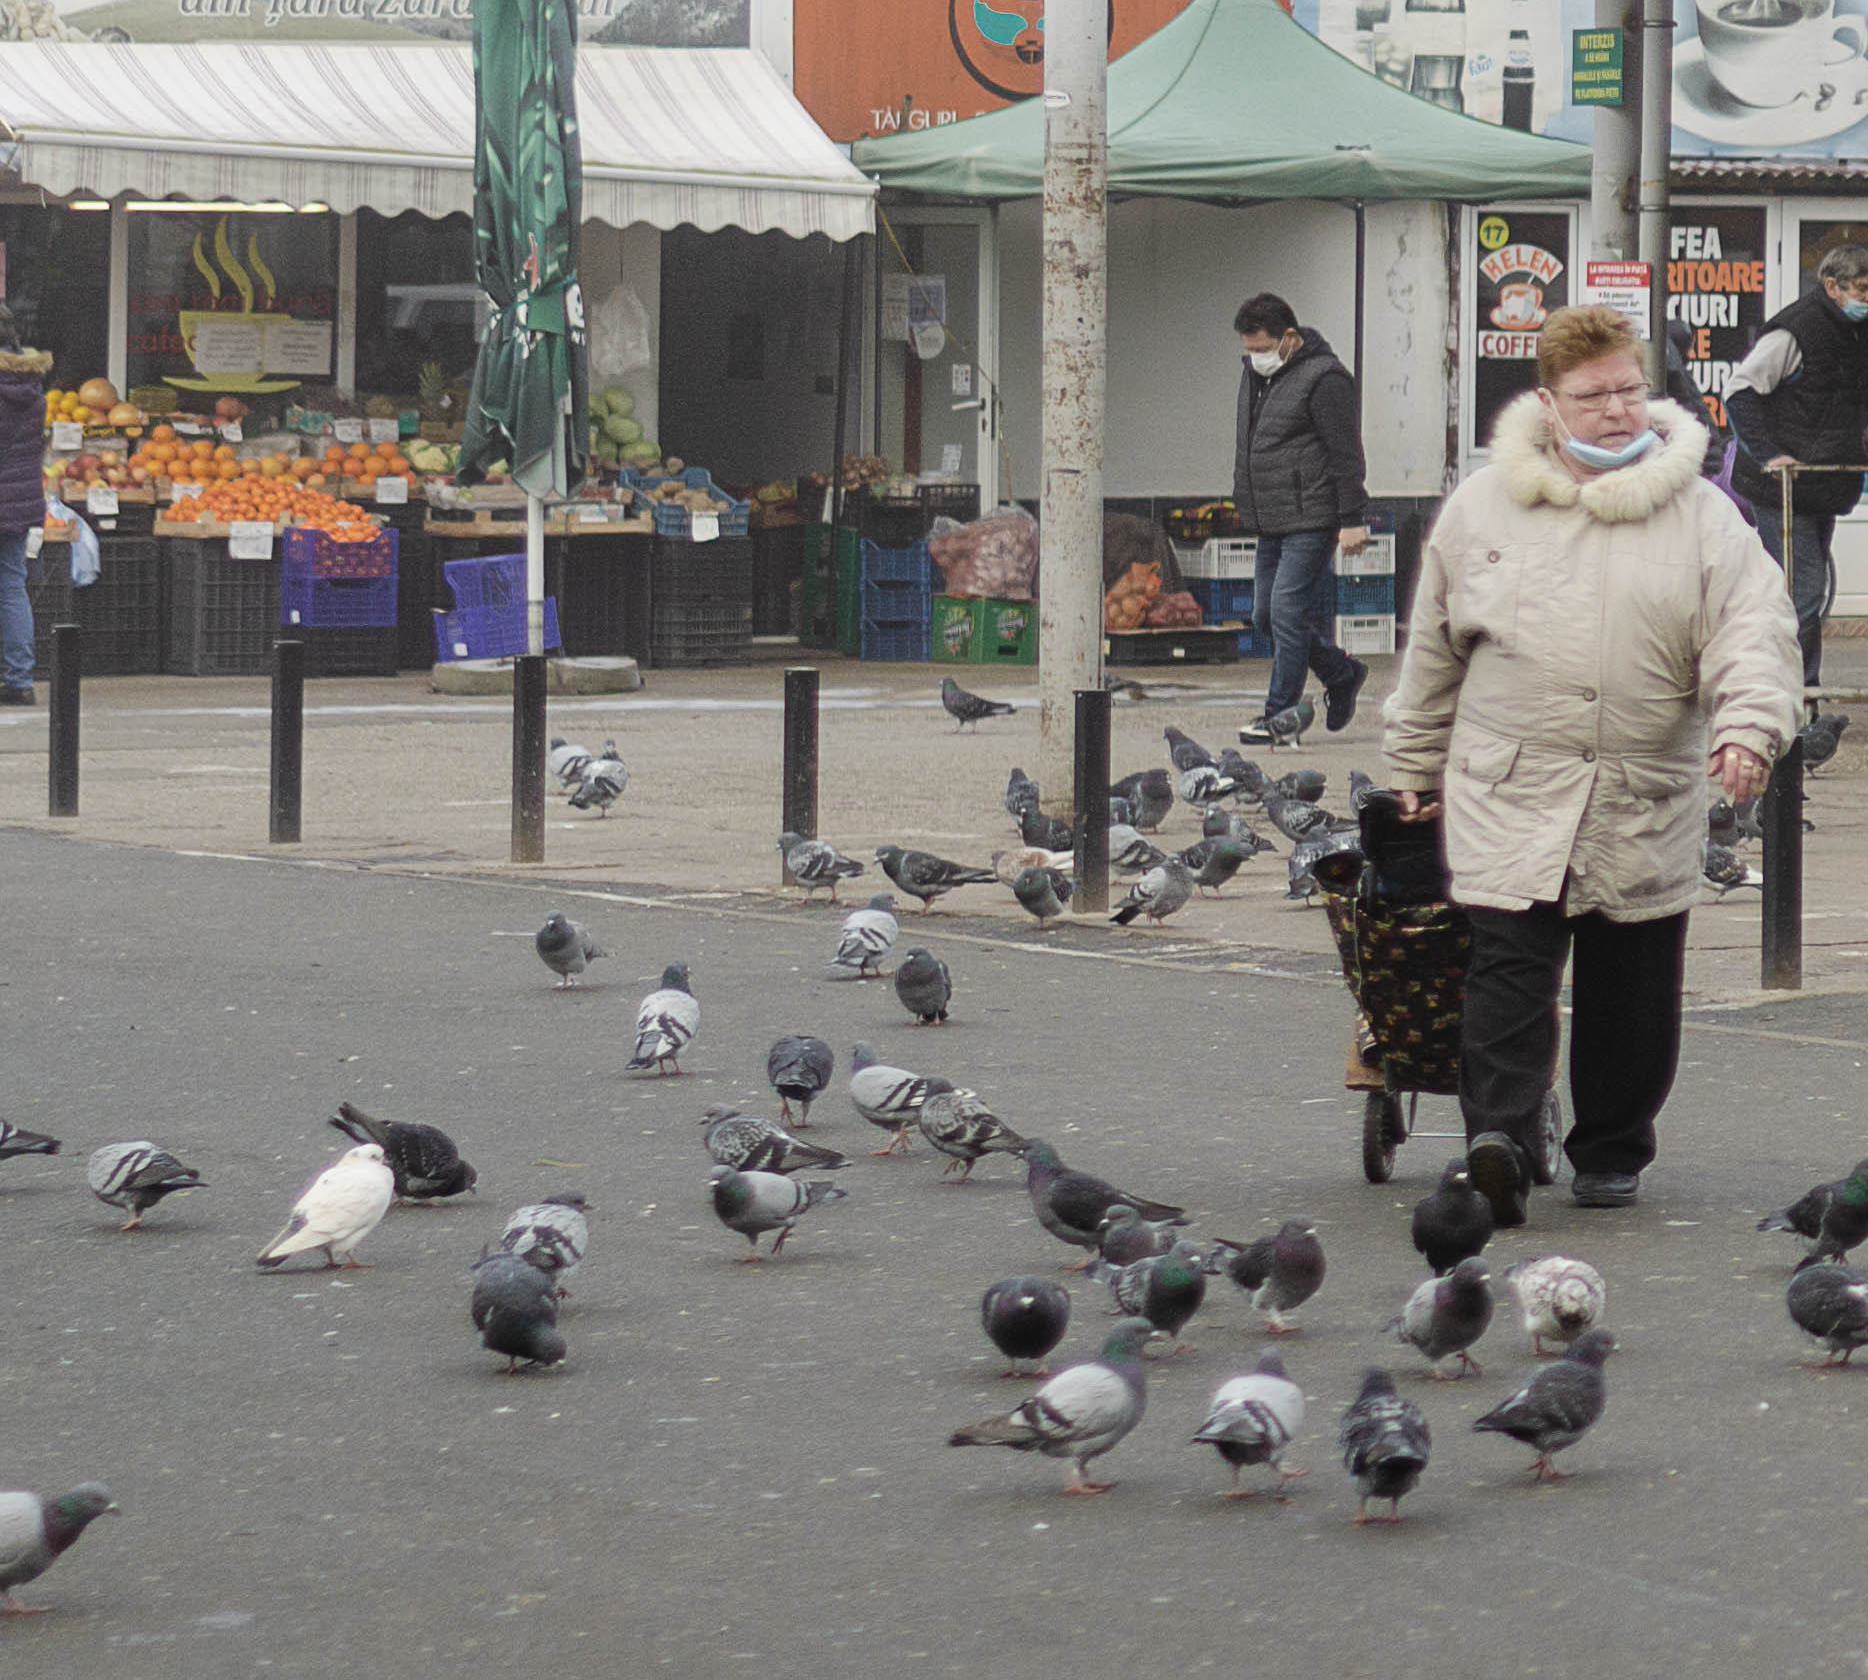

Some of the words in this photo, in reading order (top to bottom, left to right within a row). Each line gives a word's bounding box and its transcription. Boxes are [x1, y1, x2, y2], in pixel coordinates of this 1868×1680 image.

[1483, 224, 1505, 244] 17
[1670, 227, 1722, 260] FEA
[1483, 246, 1559, 284] HELEN
[1482, 334, 1541, 358] COFF
